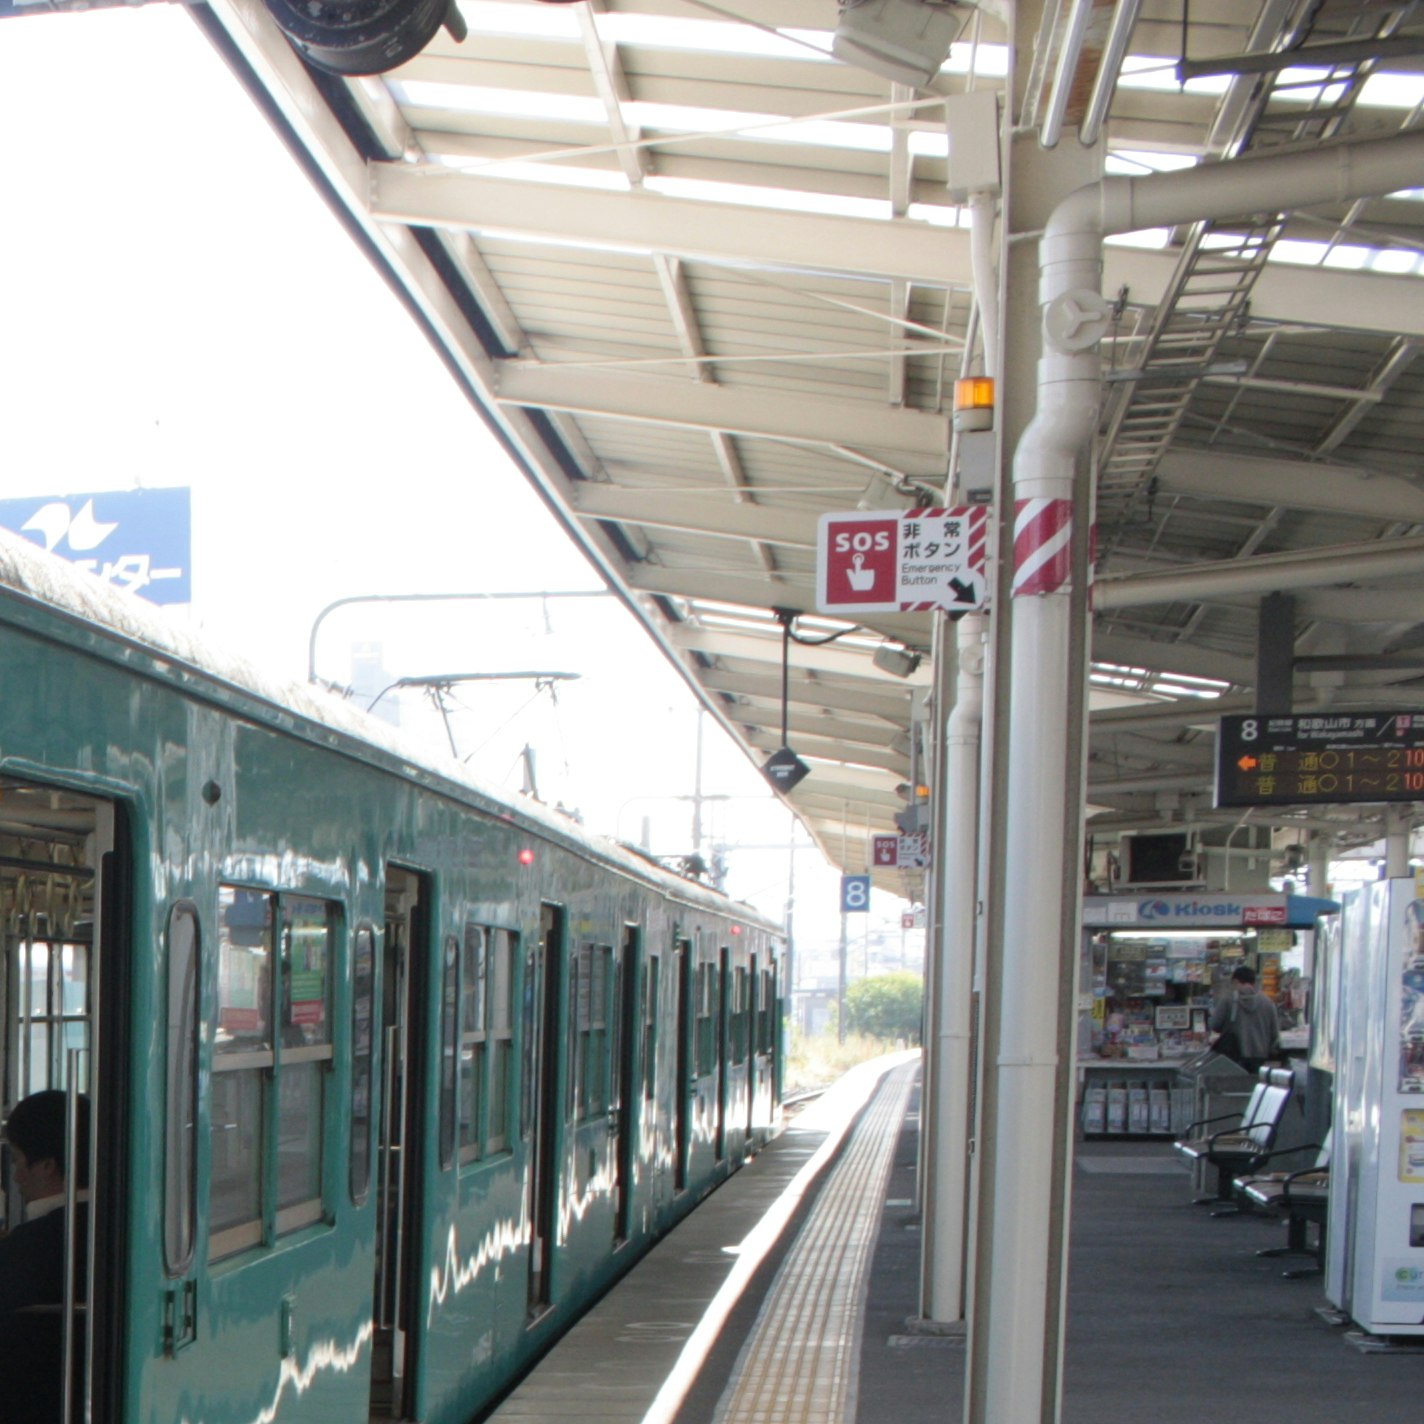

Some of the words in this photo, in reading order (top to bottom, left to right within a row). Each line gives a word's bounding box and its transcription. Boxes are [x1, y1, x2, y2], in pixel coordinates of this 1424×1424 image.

[835, 531, 890, 553] SOS
[903, 542, 961, 559] ボタン
[902, 563, 961, 574] Emergency
[902, 576, 937, 586] Button
[1241, 719, 1258, 741] 8
[846, 881, 866, 907] 8
[1175, 902, 1241, 916] Kiosk
